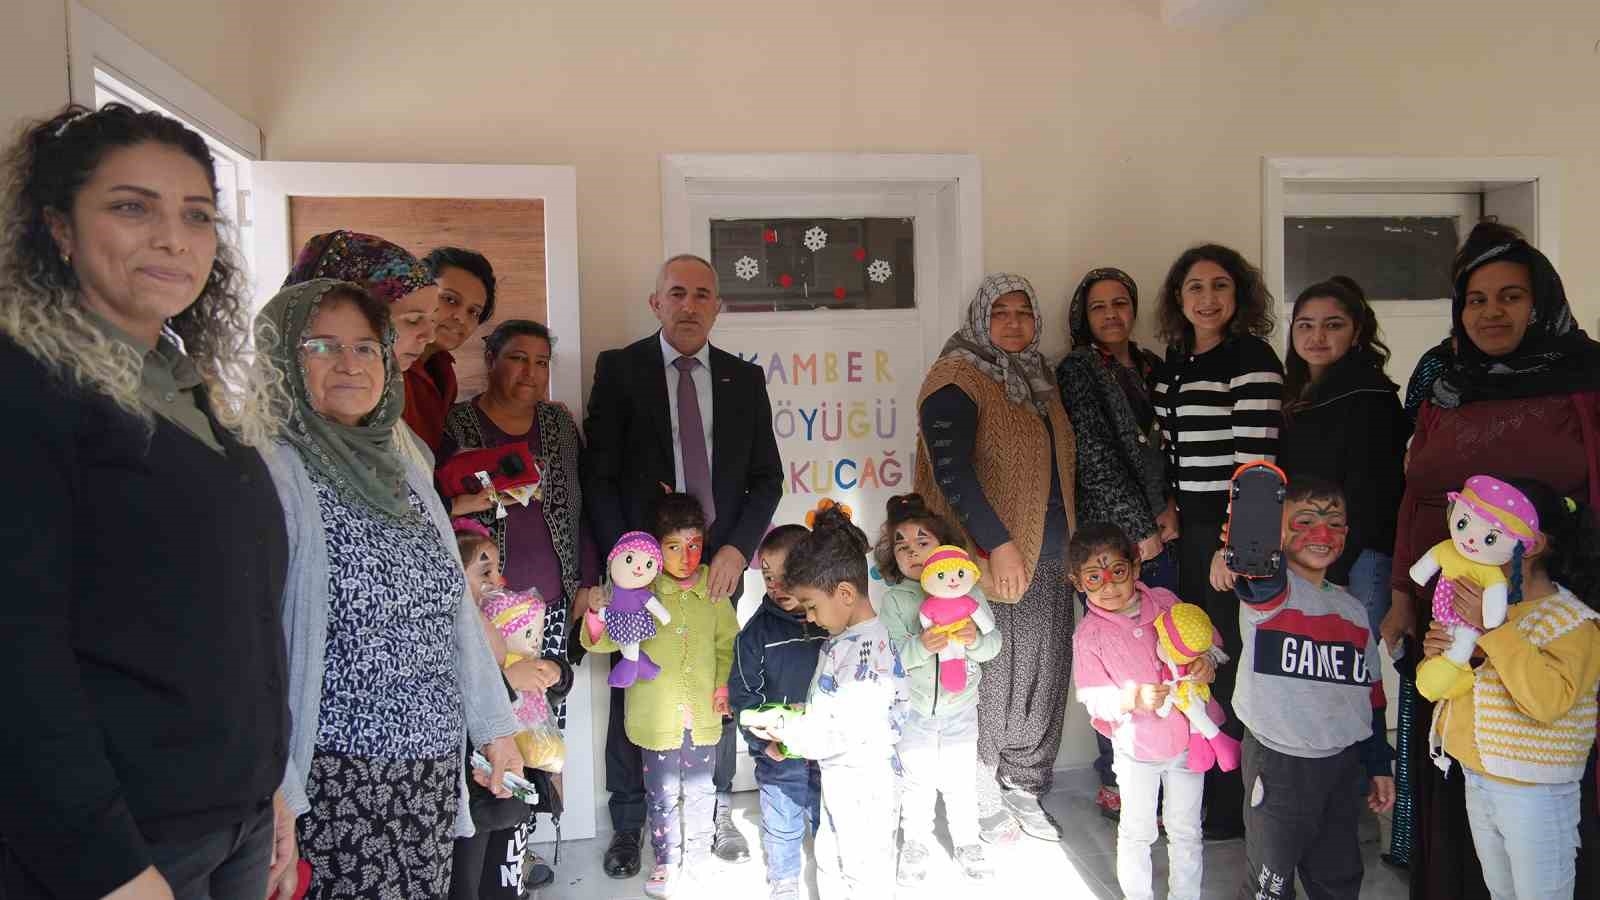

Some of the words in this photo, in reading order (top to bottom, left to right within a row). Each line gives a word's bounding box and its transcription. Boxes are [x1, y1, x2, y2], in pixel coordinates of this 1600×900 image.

[774, 399, 897, 441] ÖYÜĞÜ
[783, 450, 915, 494] KUCAĞI
[1281, 637, 1346, 680] GAME
